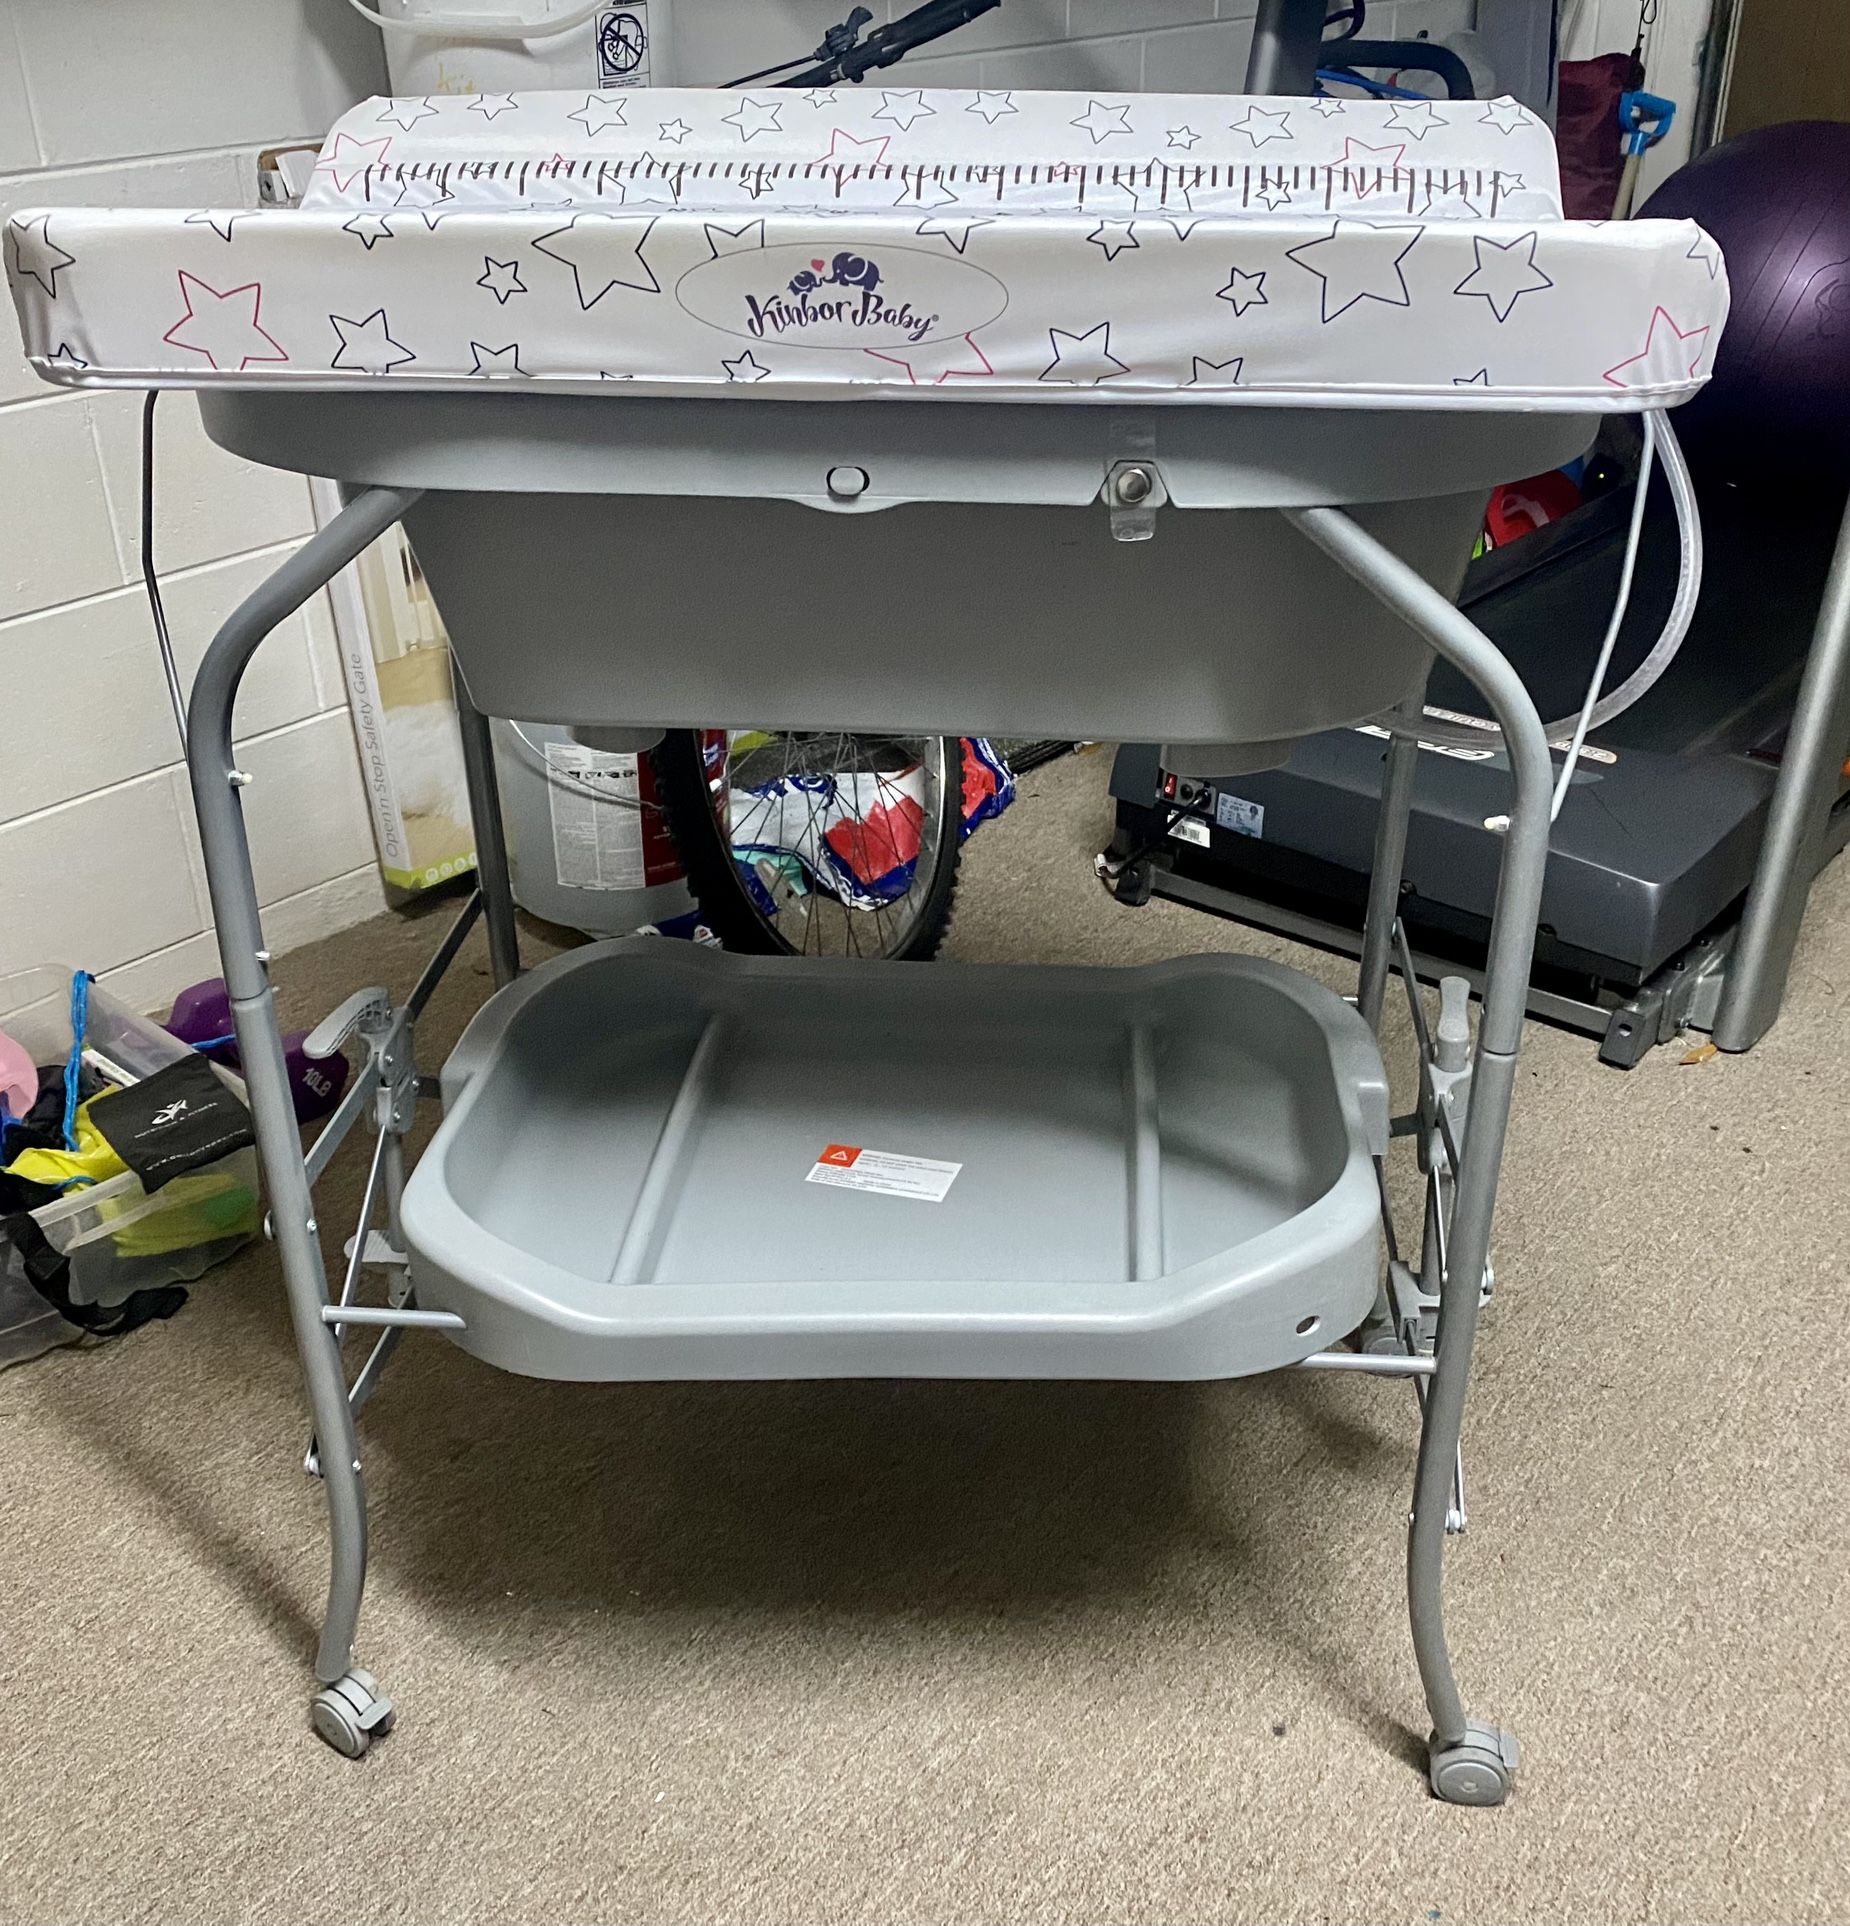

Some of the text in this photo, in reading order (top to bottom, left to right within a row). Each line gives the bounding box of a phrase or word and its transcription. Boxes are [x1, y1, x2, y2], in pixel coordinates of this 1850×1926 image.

[351, 653, 399, 858] Open'n Stop Safety Gate
[302, 1067, 332, 1097] 10LB
